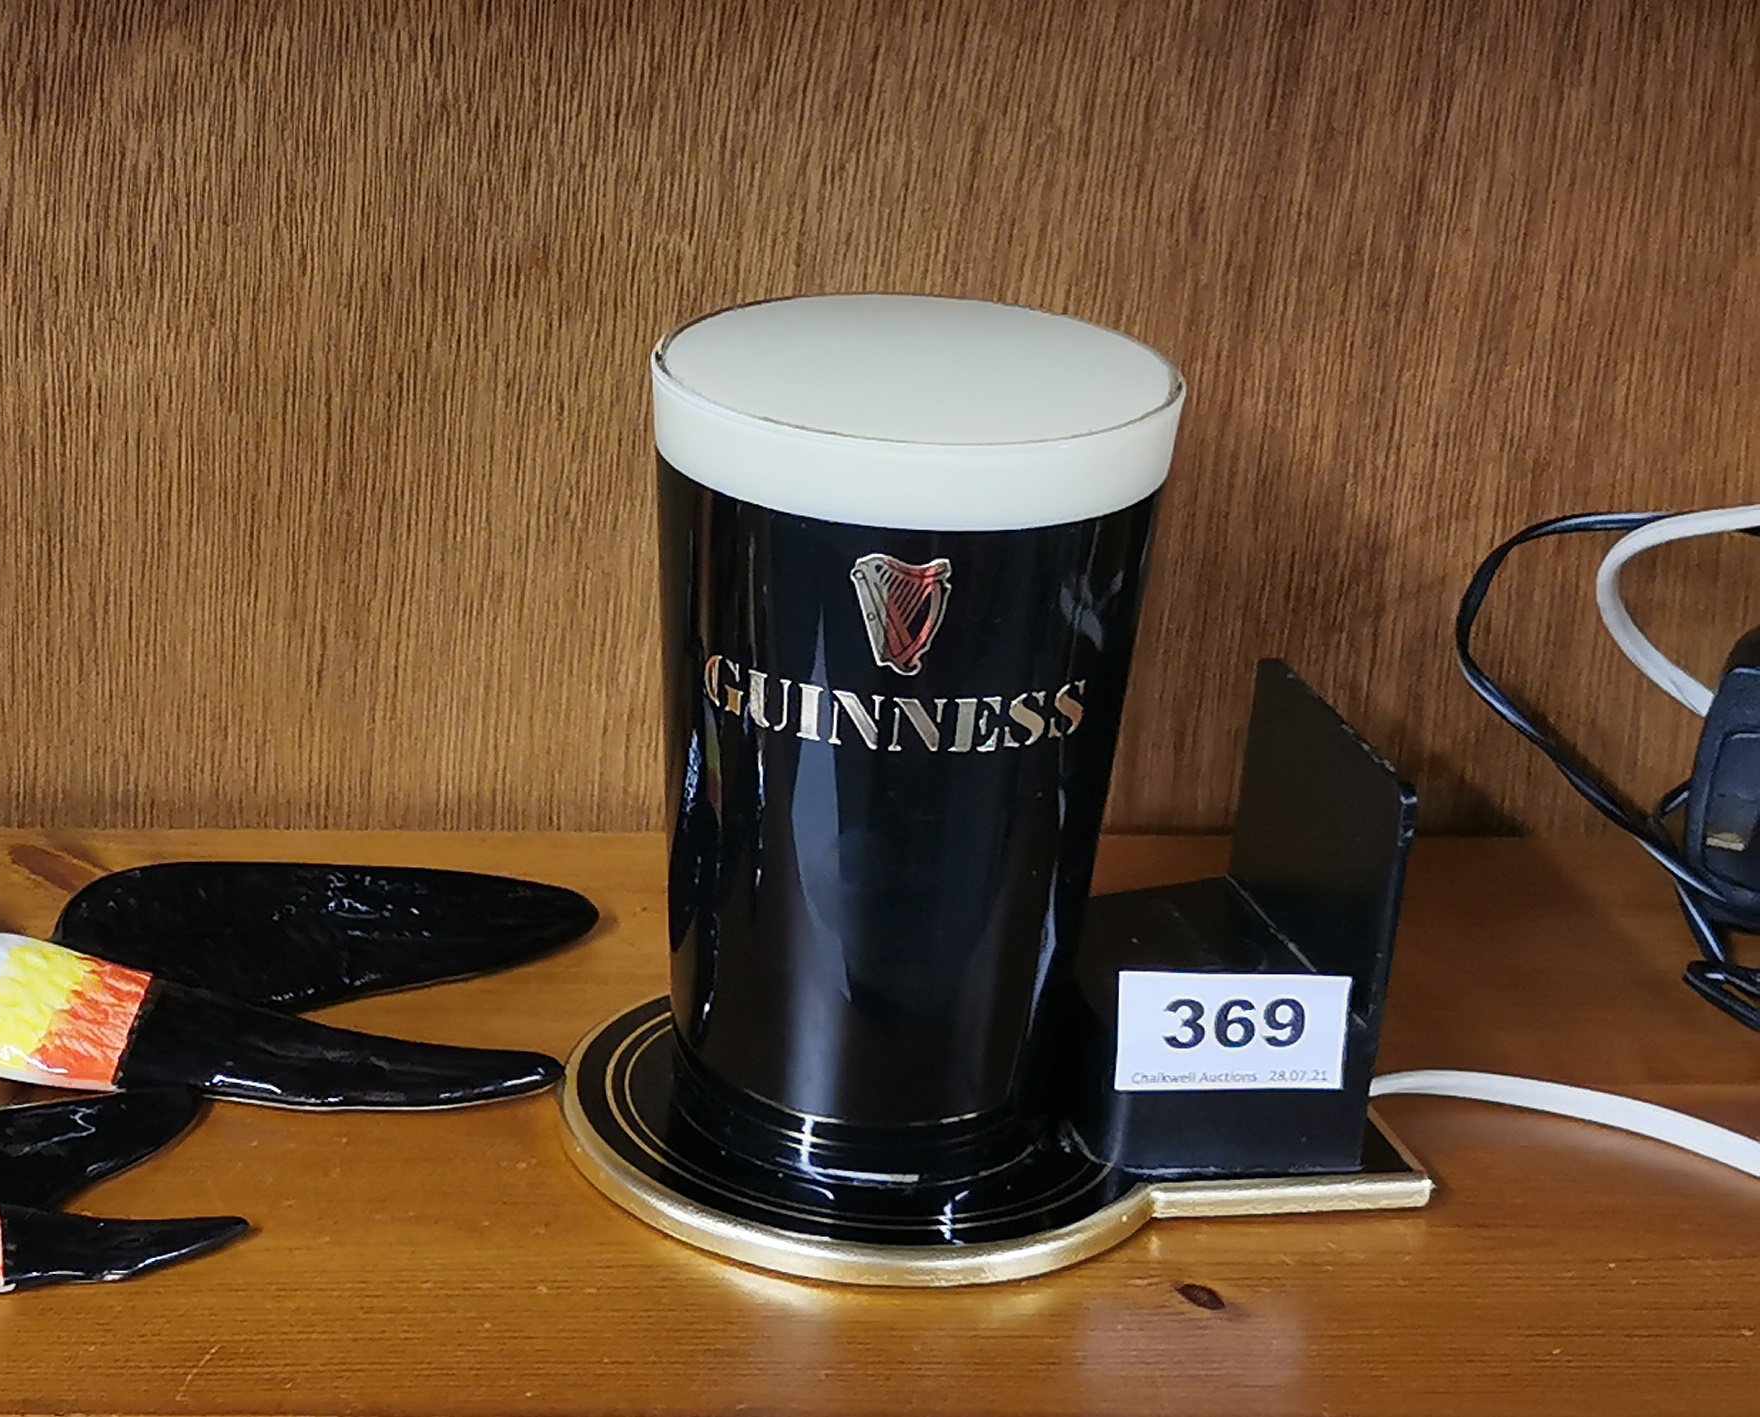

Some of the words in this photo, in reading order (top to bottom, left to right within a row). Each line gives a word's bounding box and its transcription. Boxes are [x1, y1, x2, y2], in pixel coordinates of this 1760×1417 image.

[702, 654, 1087, 752] GUINNESS
[1161, 997, 1307, 1050] 369
[1131, 1071, 1196, 1084] Chalkwell
[1198, 1071, 1258, 1084] Auctions
[1268, 1069, 1328, 1082] 28.07.21
